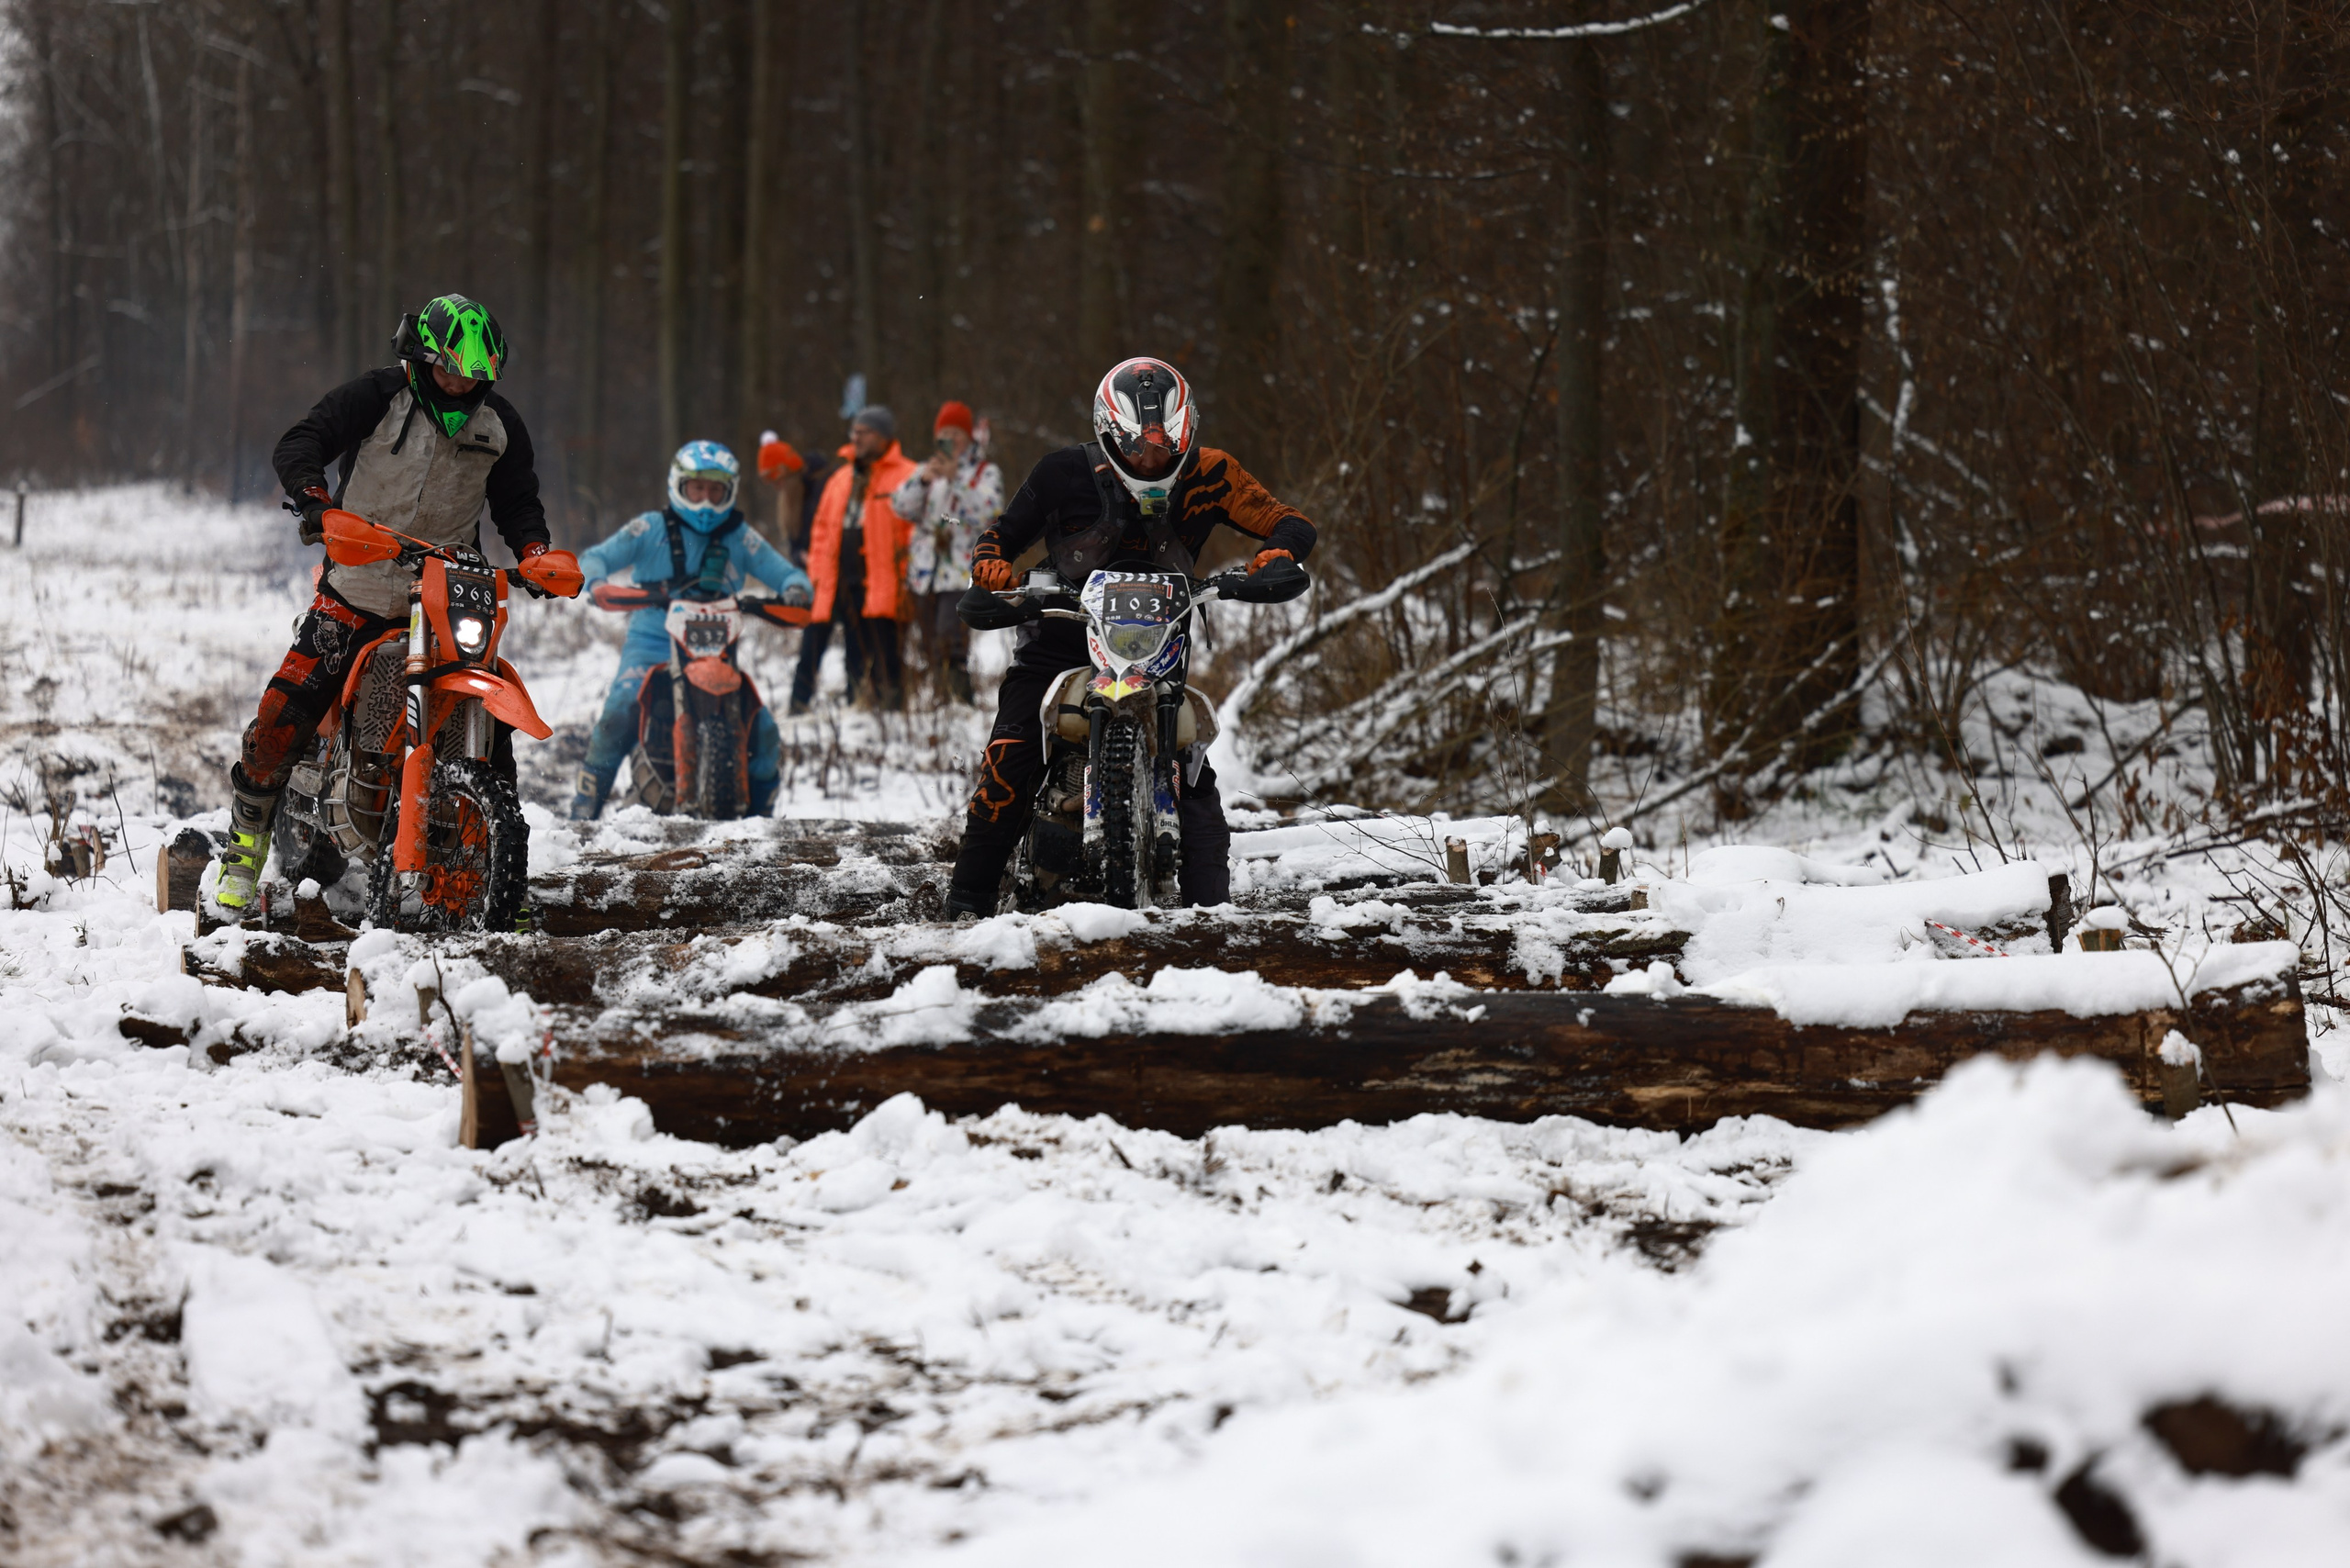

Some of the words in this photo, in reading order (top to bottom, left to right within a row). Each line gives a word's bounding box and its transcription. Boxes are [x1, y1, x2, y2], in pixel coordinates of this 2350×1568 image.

[453, 584, 492, 605] 968
[1109, 597, 1161, 613] 103
[689, 629, 724, 643] 037
